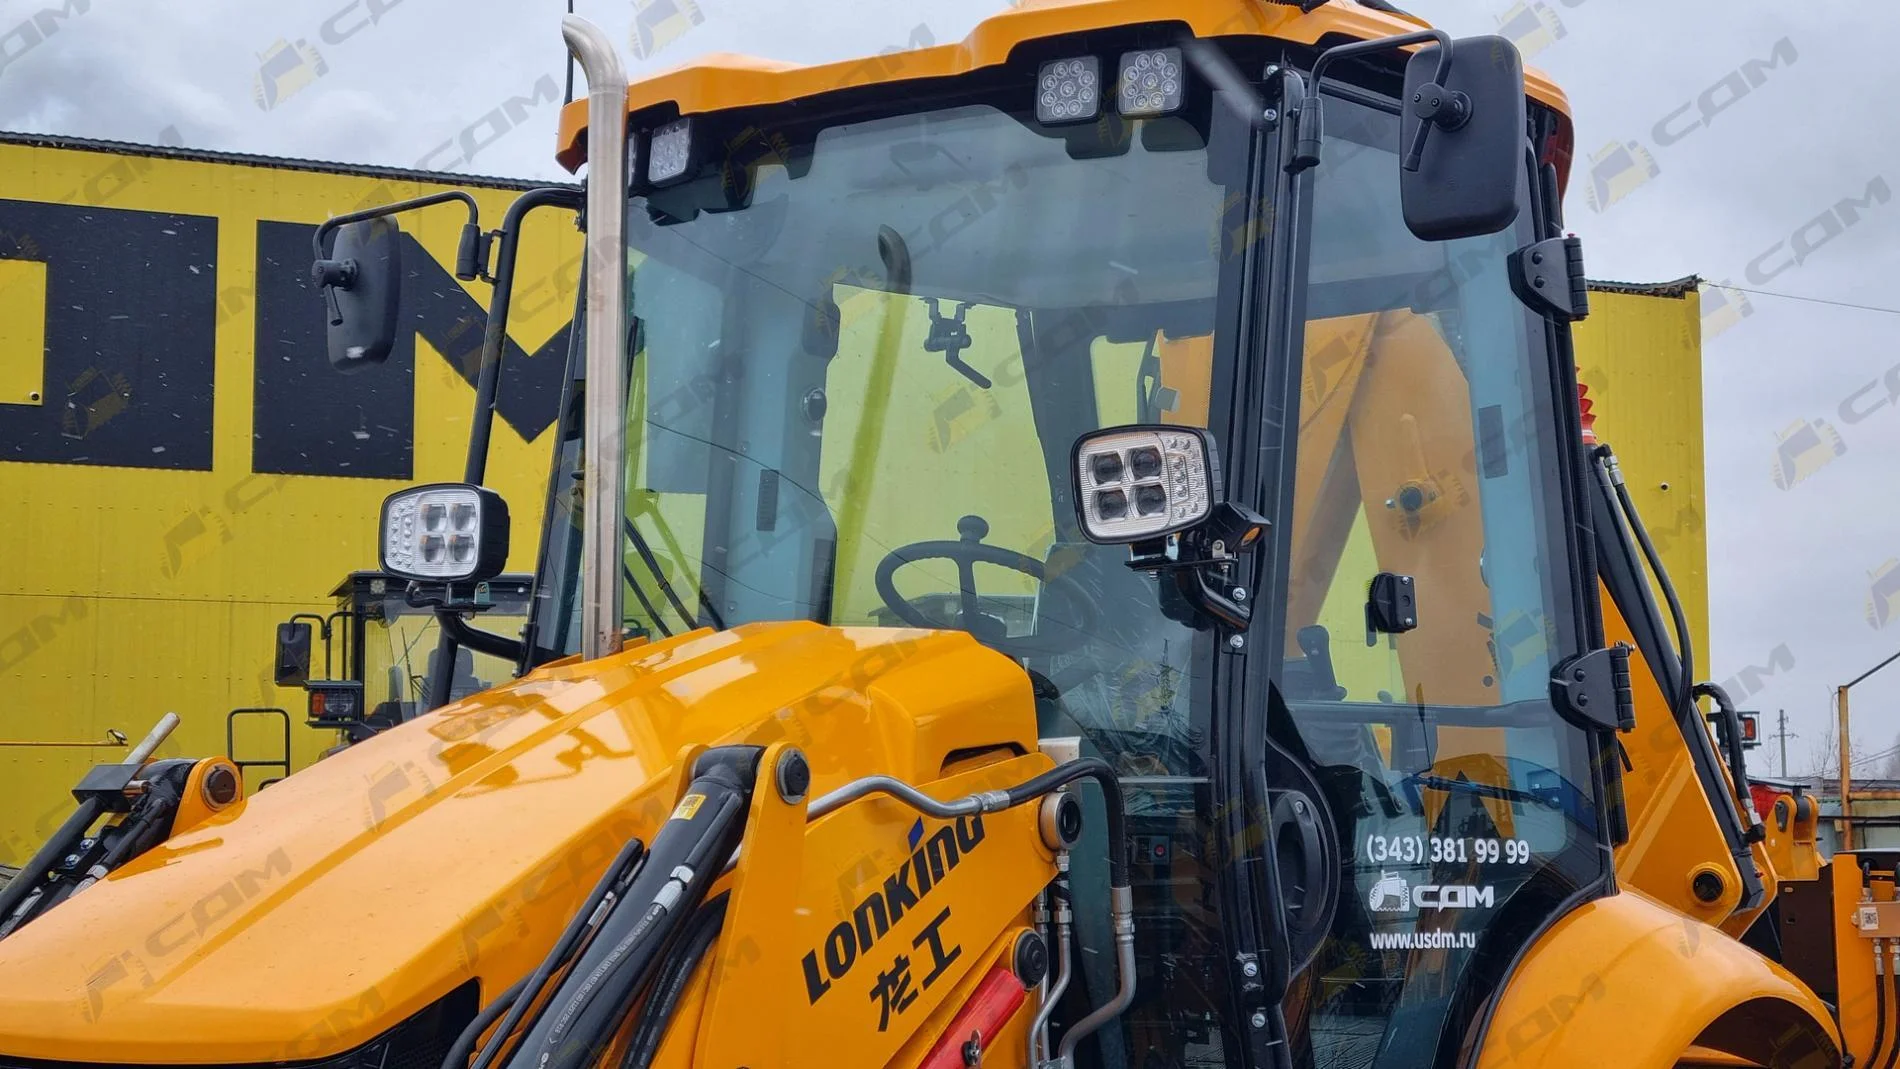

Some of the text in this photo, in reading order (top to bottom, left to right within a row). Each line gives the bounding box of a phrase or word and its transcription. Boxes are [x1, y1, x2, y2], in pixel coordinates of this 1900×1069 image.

[1367, 834, 1530, 865] (343) 381 99 99
[1370, 927, 1476, 950] www.usdm.ru
